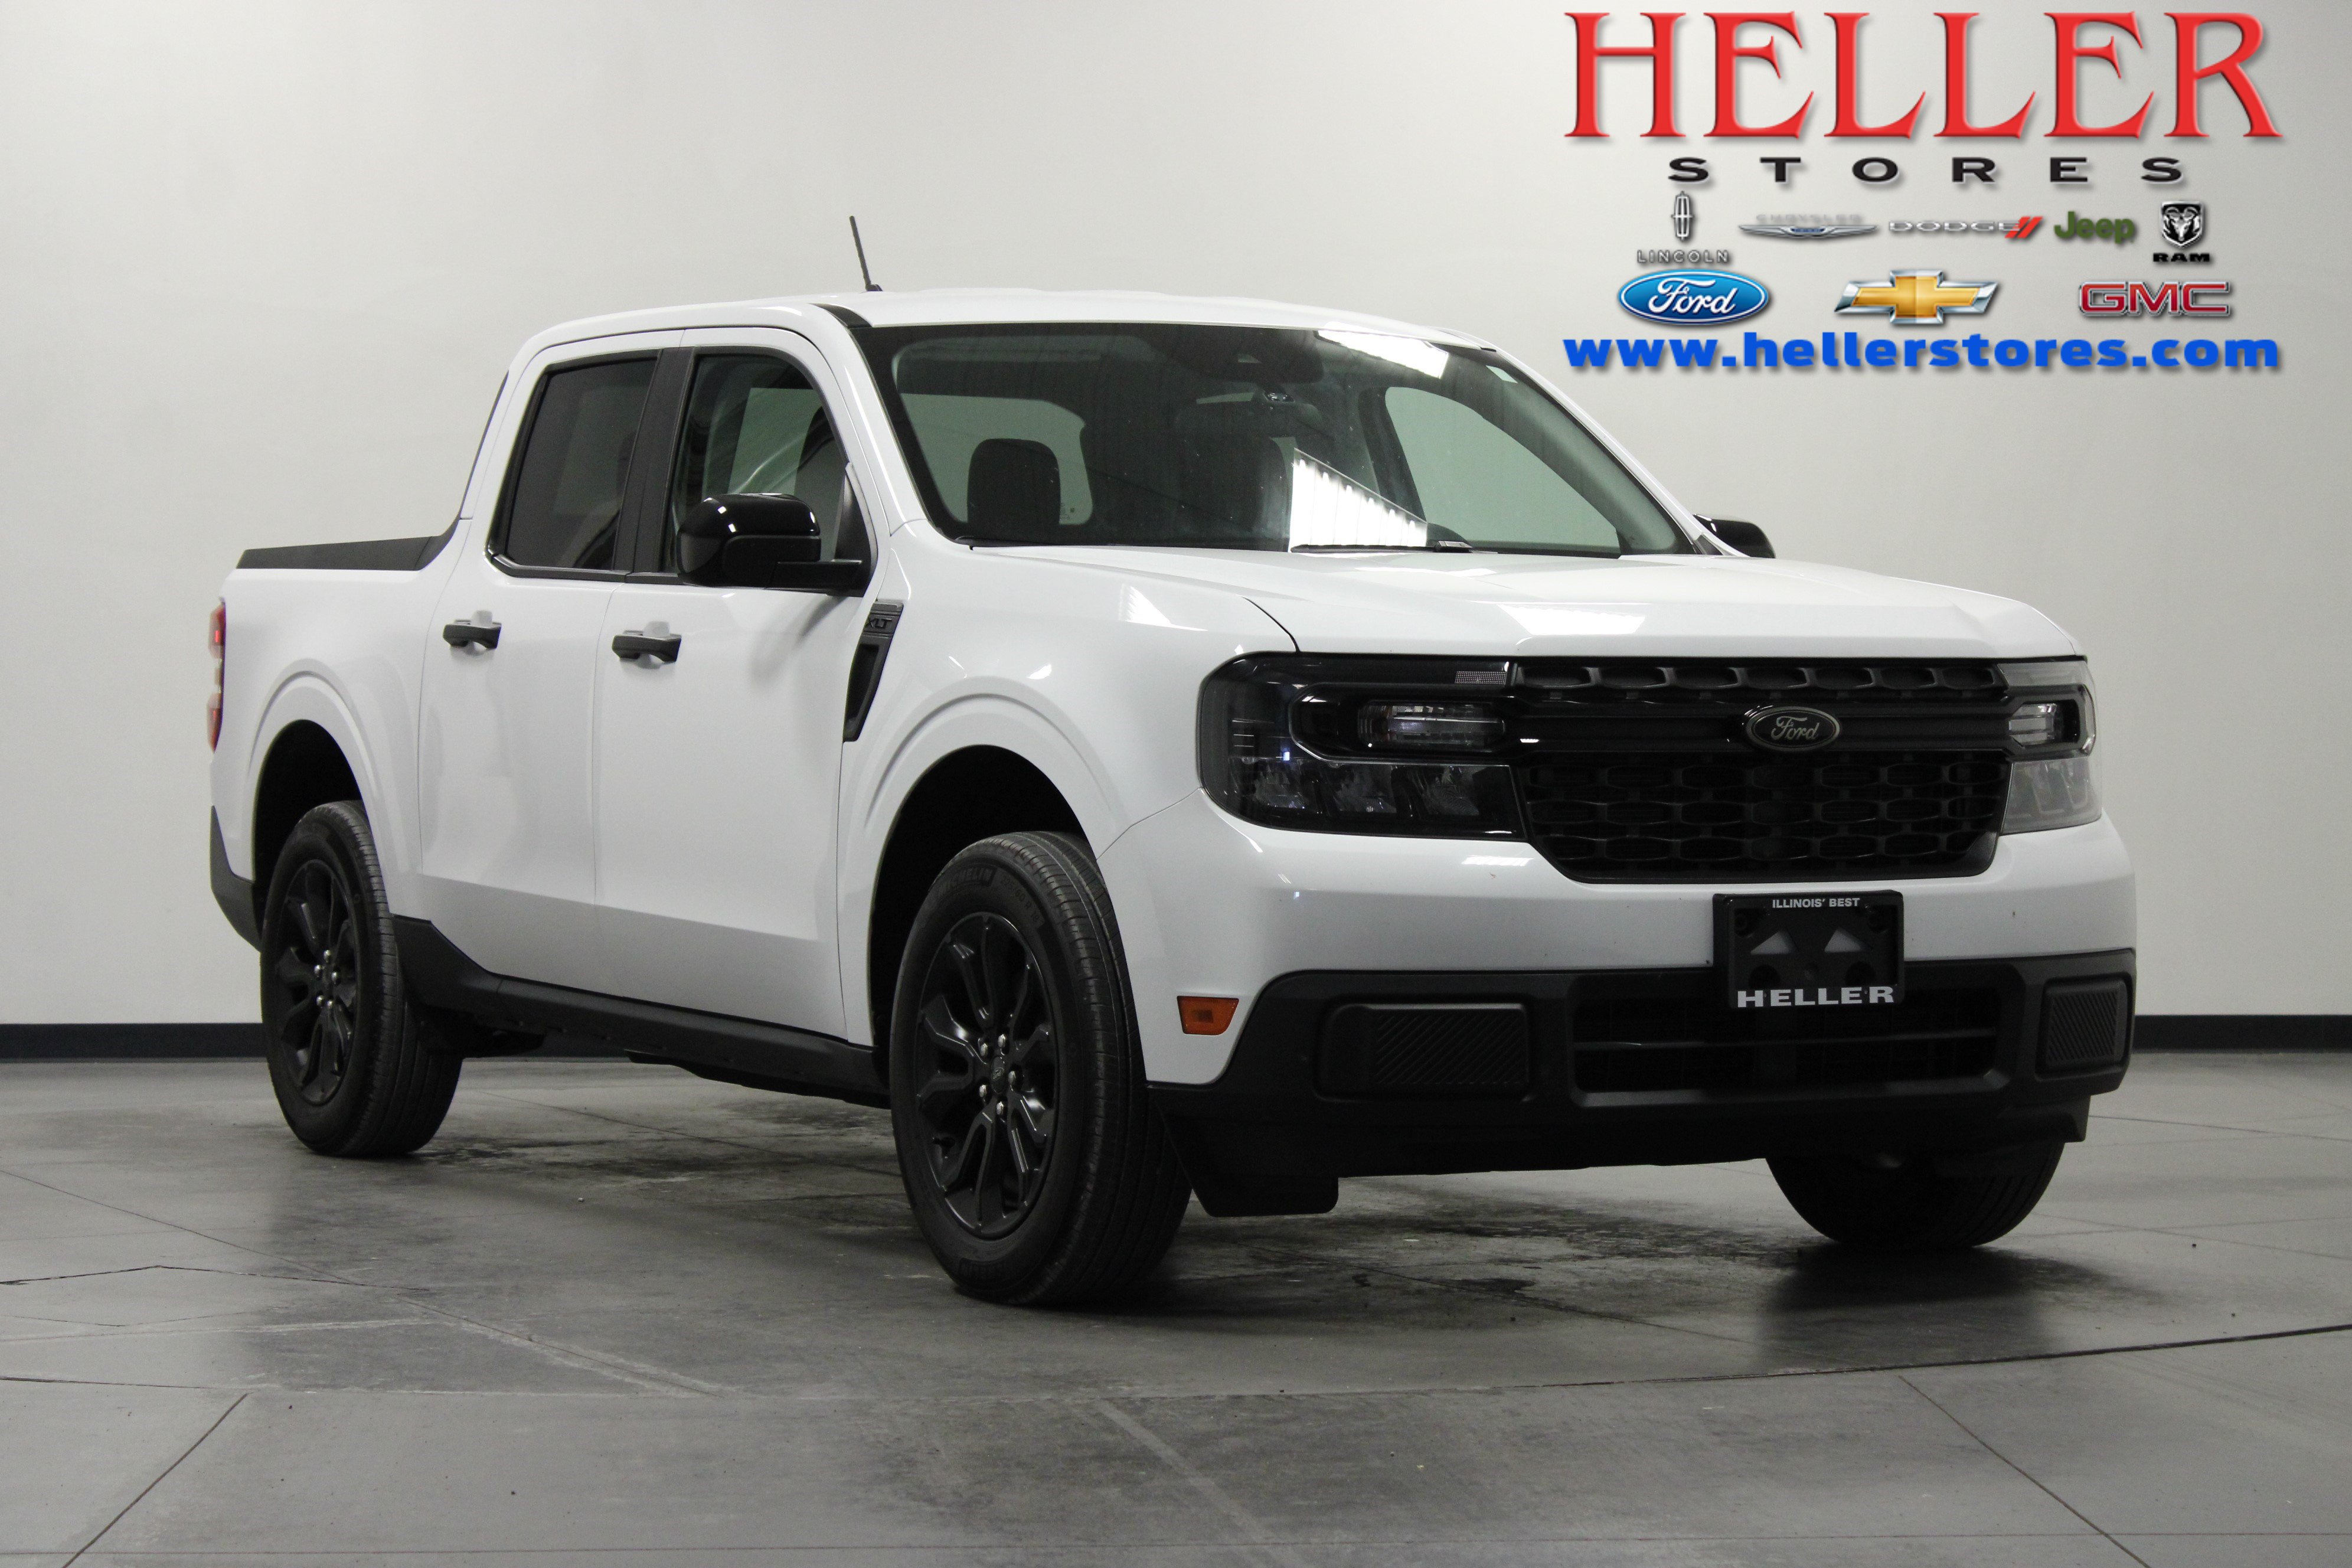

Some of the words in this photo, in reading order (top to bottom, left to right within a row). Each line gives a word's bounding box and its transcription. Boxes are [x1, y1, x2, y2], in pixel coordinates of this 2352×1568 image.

[865, 617, 893, 629] XLT
[1771, 716, 1820, 740] Ford
[1829, 897, 1860, 907] BEST
[1737, 986, 1894, 1008] HELLER
